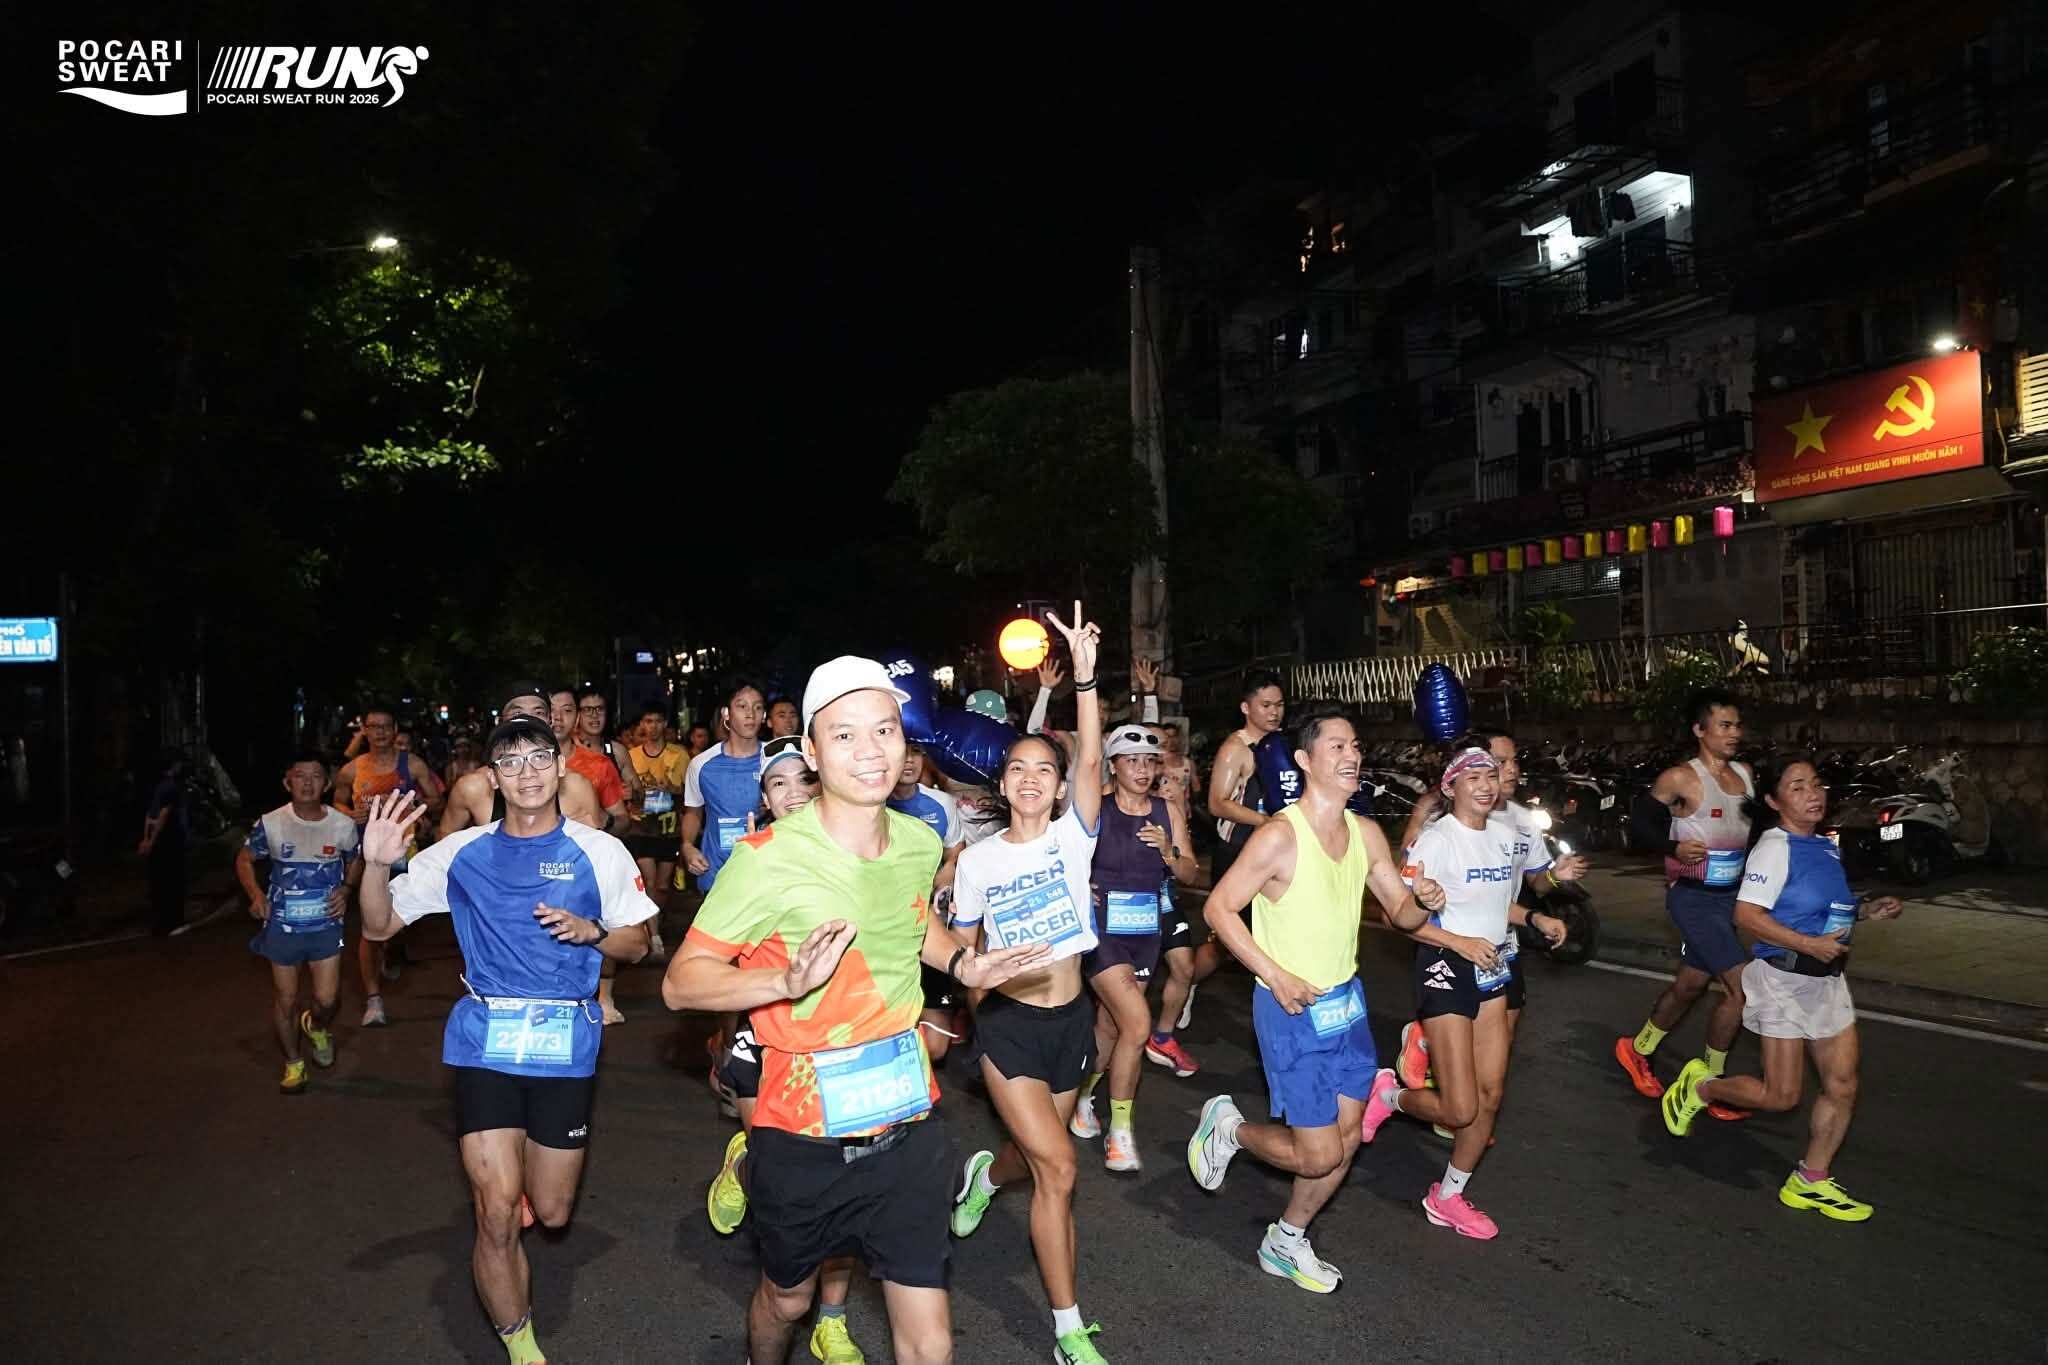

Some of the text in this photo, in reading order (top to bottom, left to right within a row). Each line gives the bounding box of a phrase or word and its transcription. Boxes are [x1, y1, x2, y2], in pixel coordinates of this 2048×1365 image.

[1828, 466, 1844, 479] VIỆT
[1845, 463, 1862, 476] NAM
[1863, 459, 1890, 472] QUANG
[1891, 455, 1911, 467] VINH
[985, 858, 1065, 904] PACER
[1004, 909, 1076, 948] PACER
